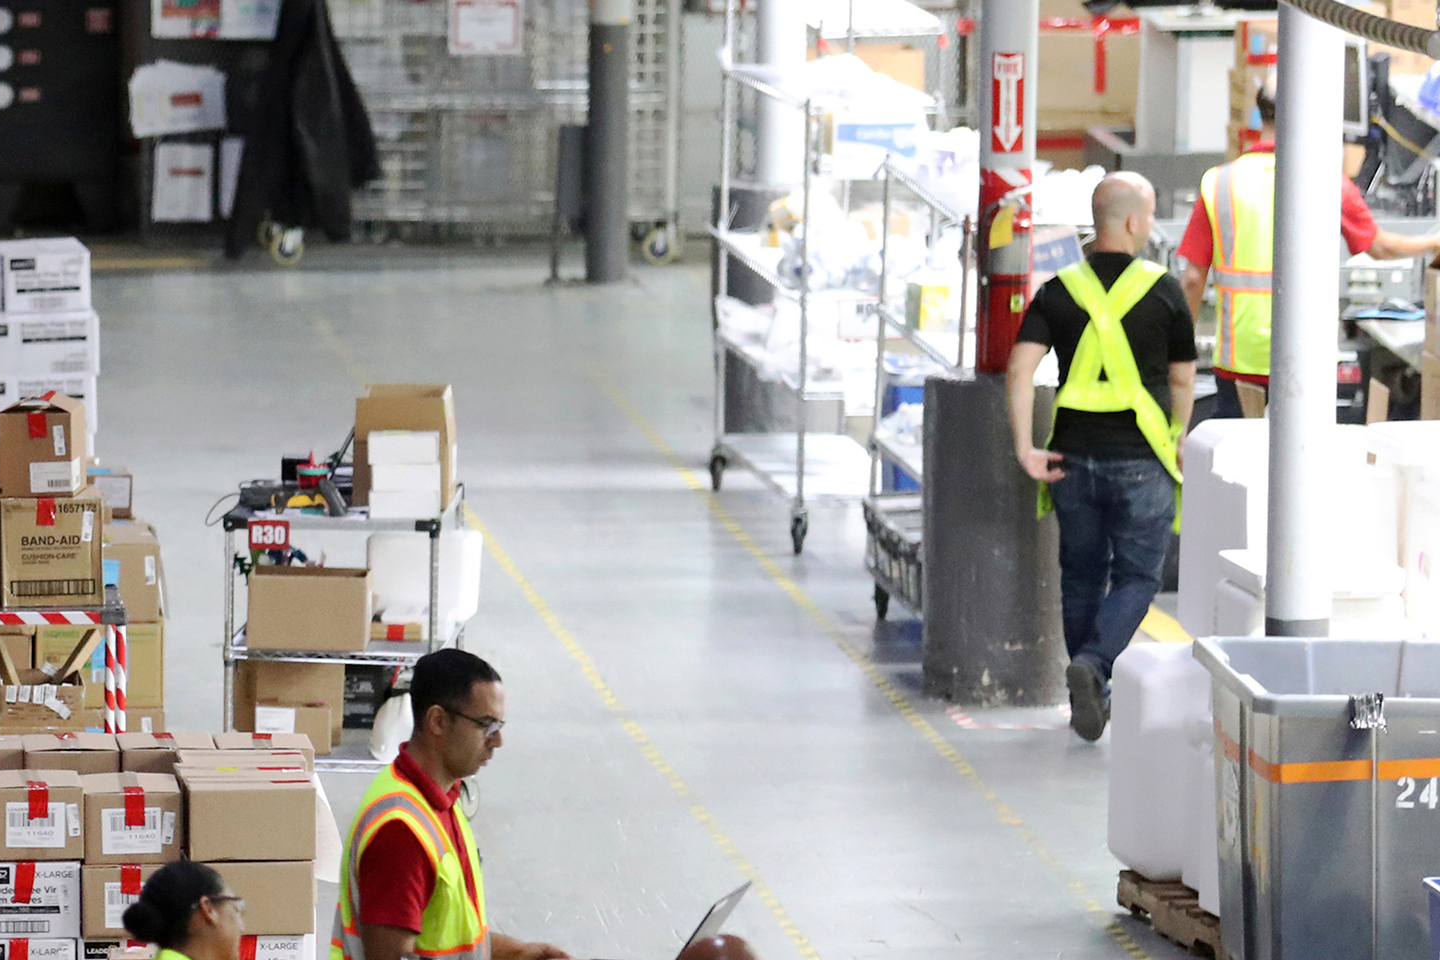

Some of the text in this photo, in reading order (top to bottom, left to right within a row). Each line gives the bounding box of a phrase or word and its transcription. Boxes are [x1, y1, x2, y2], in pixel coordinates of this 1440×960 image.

[21, 535, 81, 546] BAND-AID
[252, 525, 286, 545] R30
[1395, 776, 1438, 809] 24
[260, 942, 298, 950] X-LARGE
